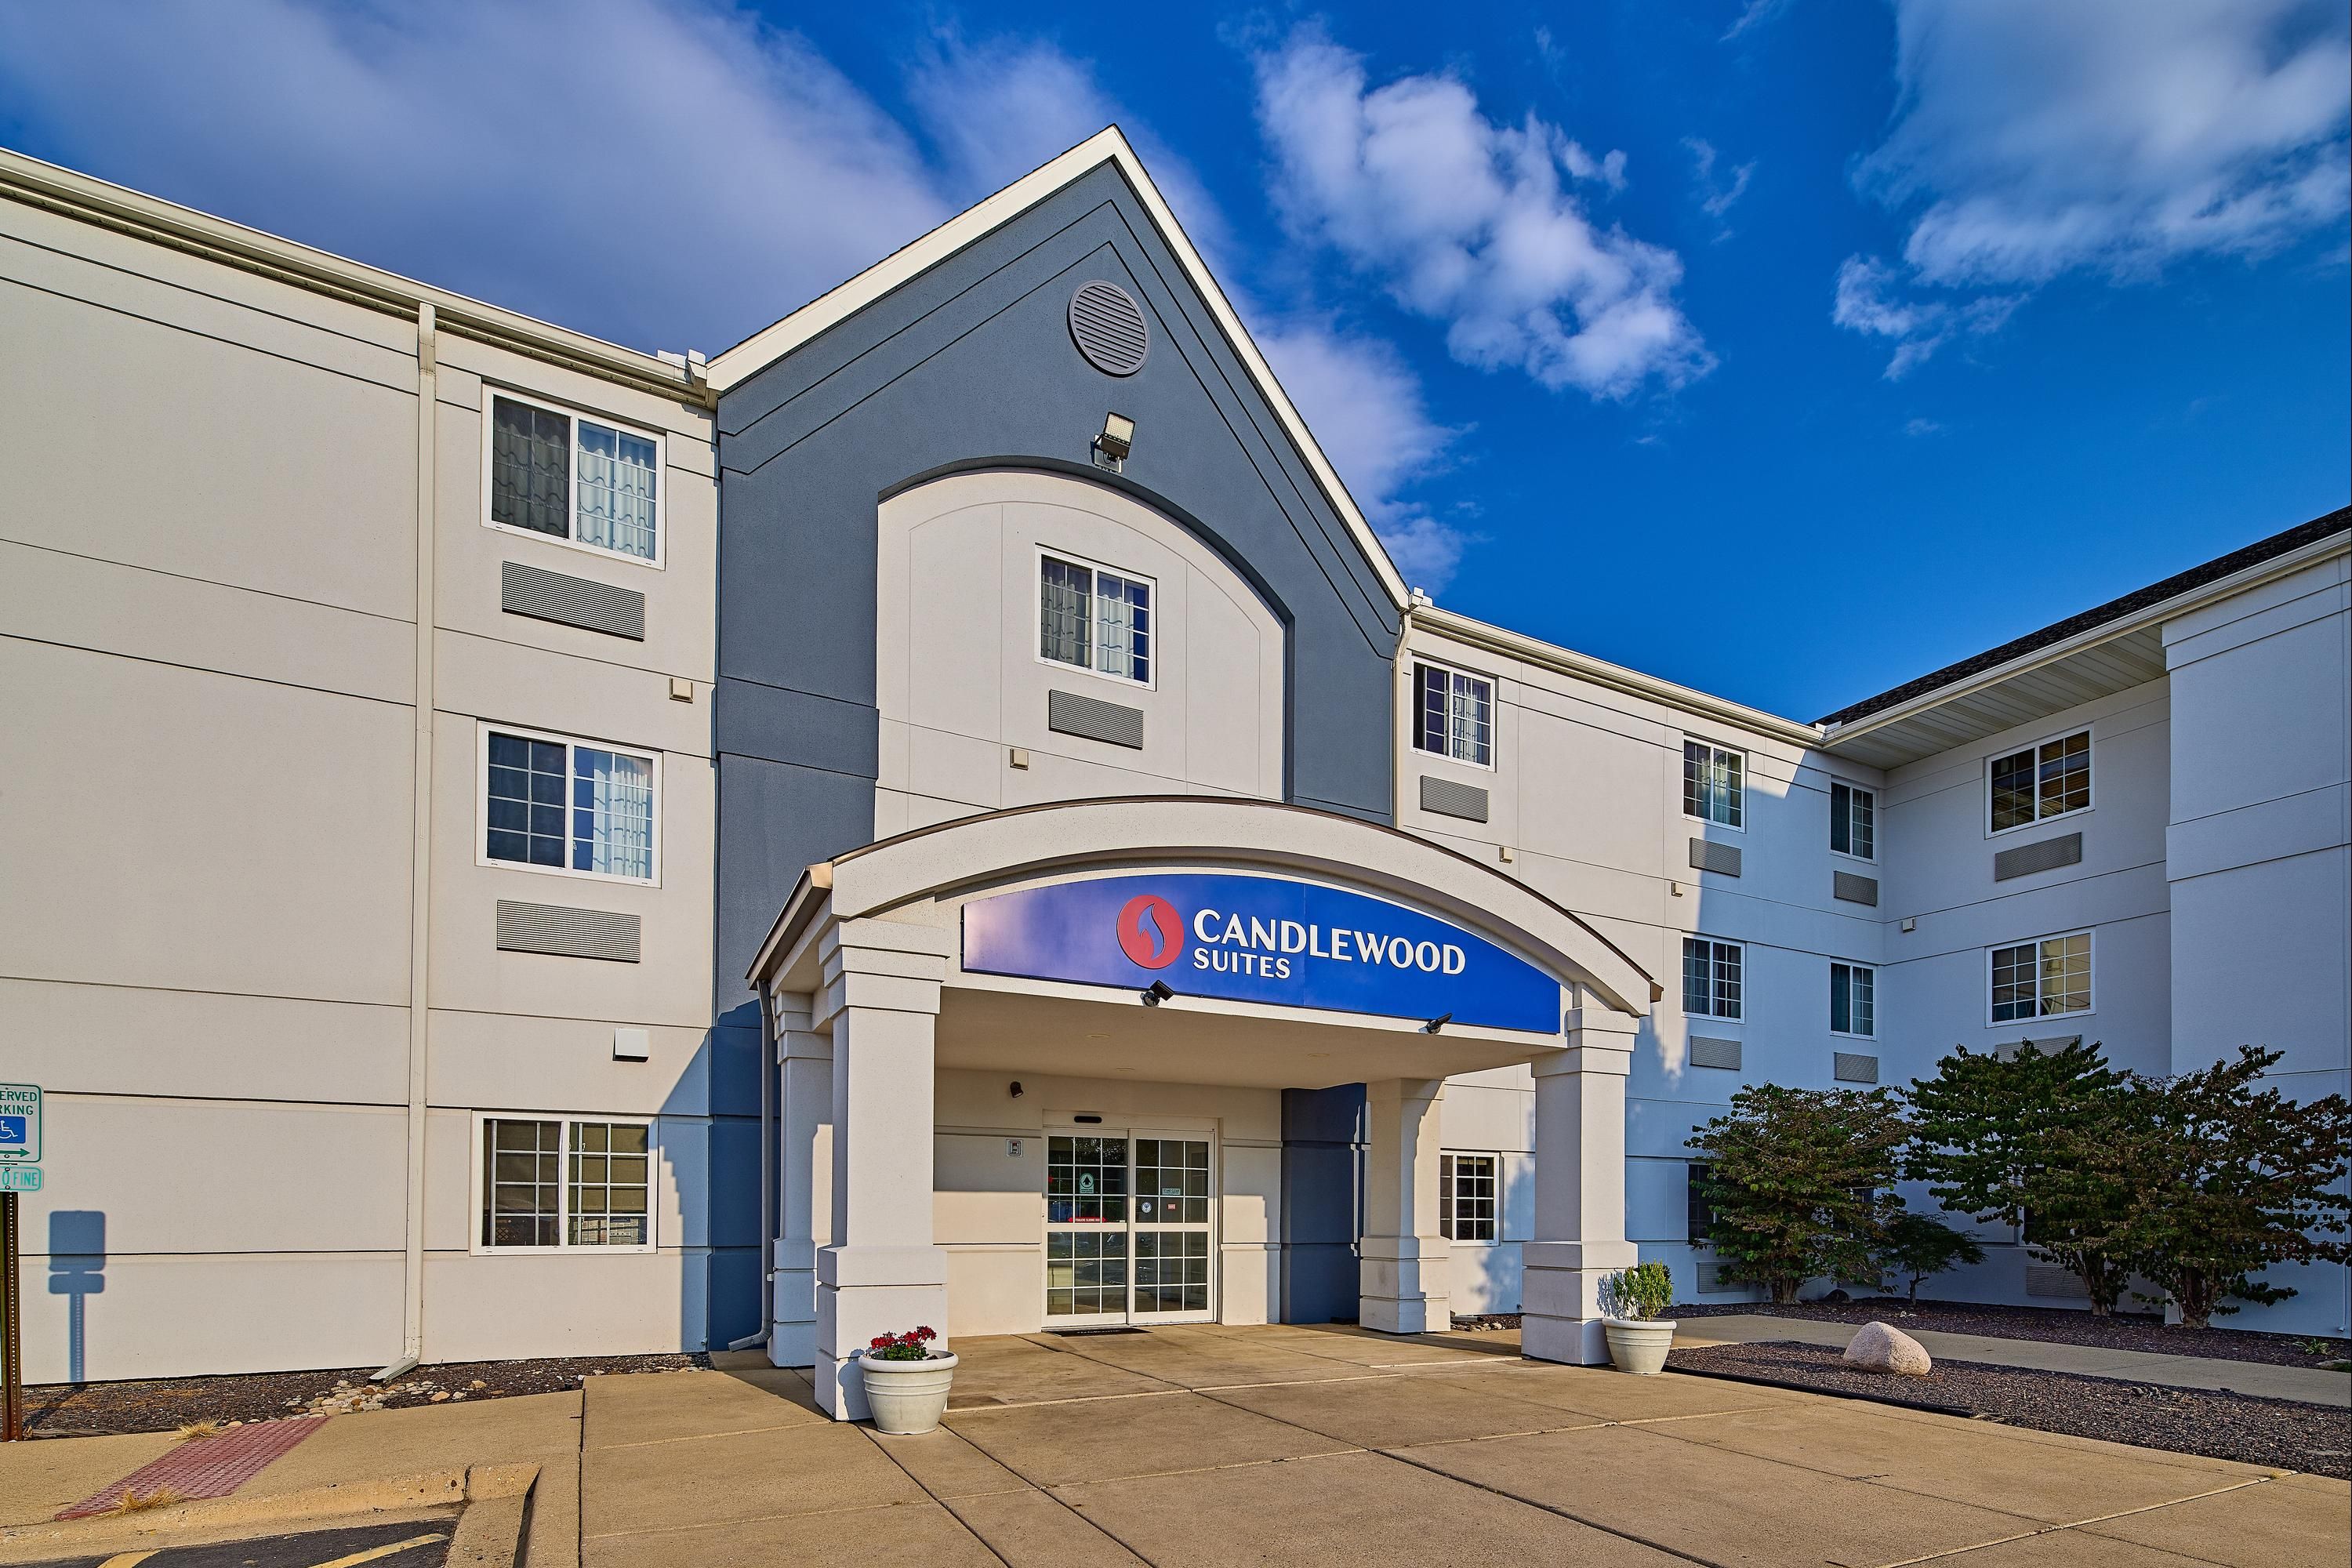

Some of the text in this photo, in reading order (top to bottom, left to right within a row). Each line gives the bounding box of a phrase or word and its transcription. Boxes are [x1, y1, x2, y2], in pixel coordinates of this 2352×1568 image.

[1193, 909, 1466, 975] CANDLEWOOD
[1192, 947, 1290, 979] SUITES
[13, 1171, 38, 1186] FINE
